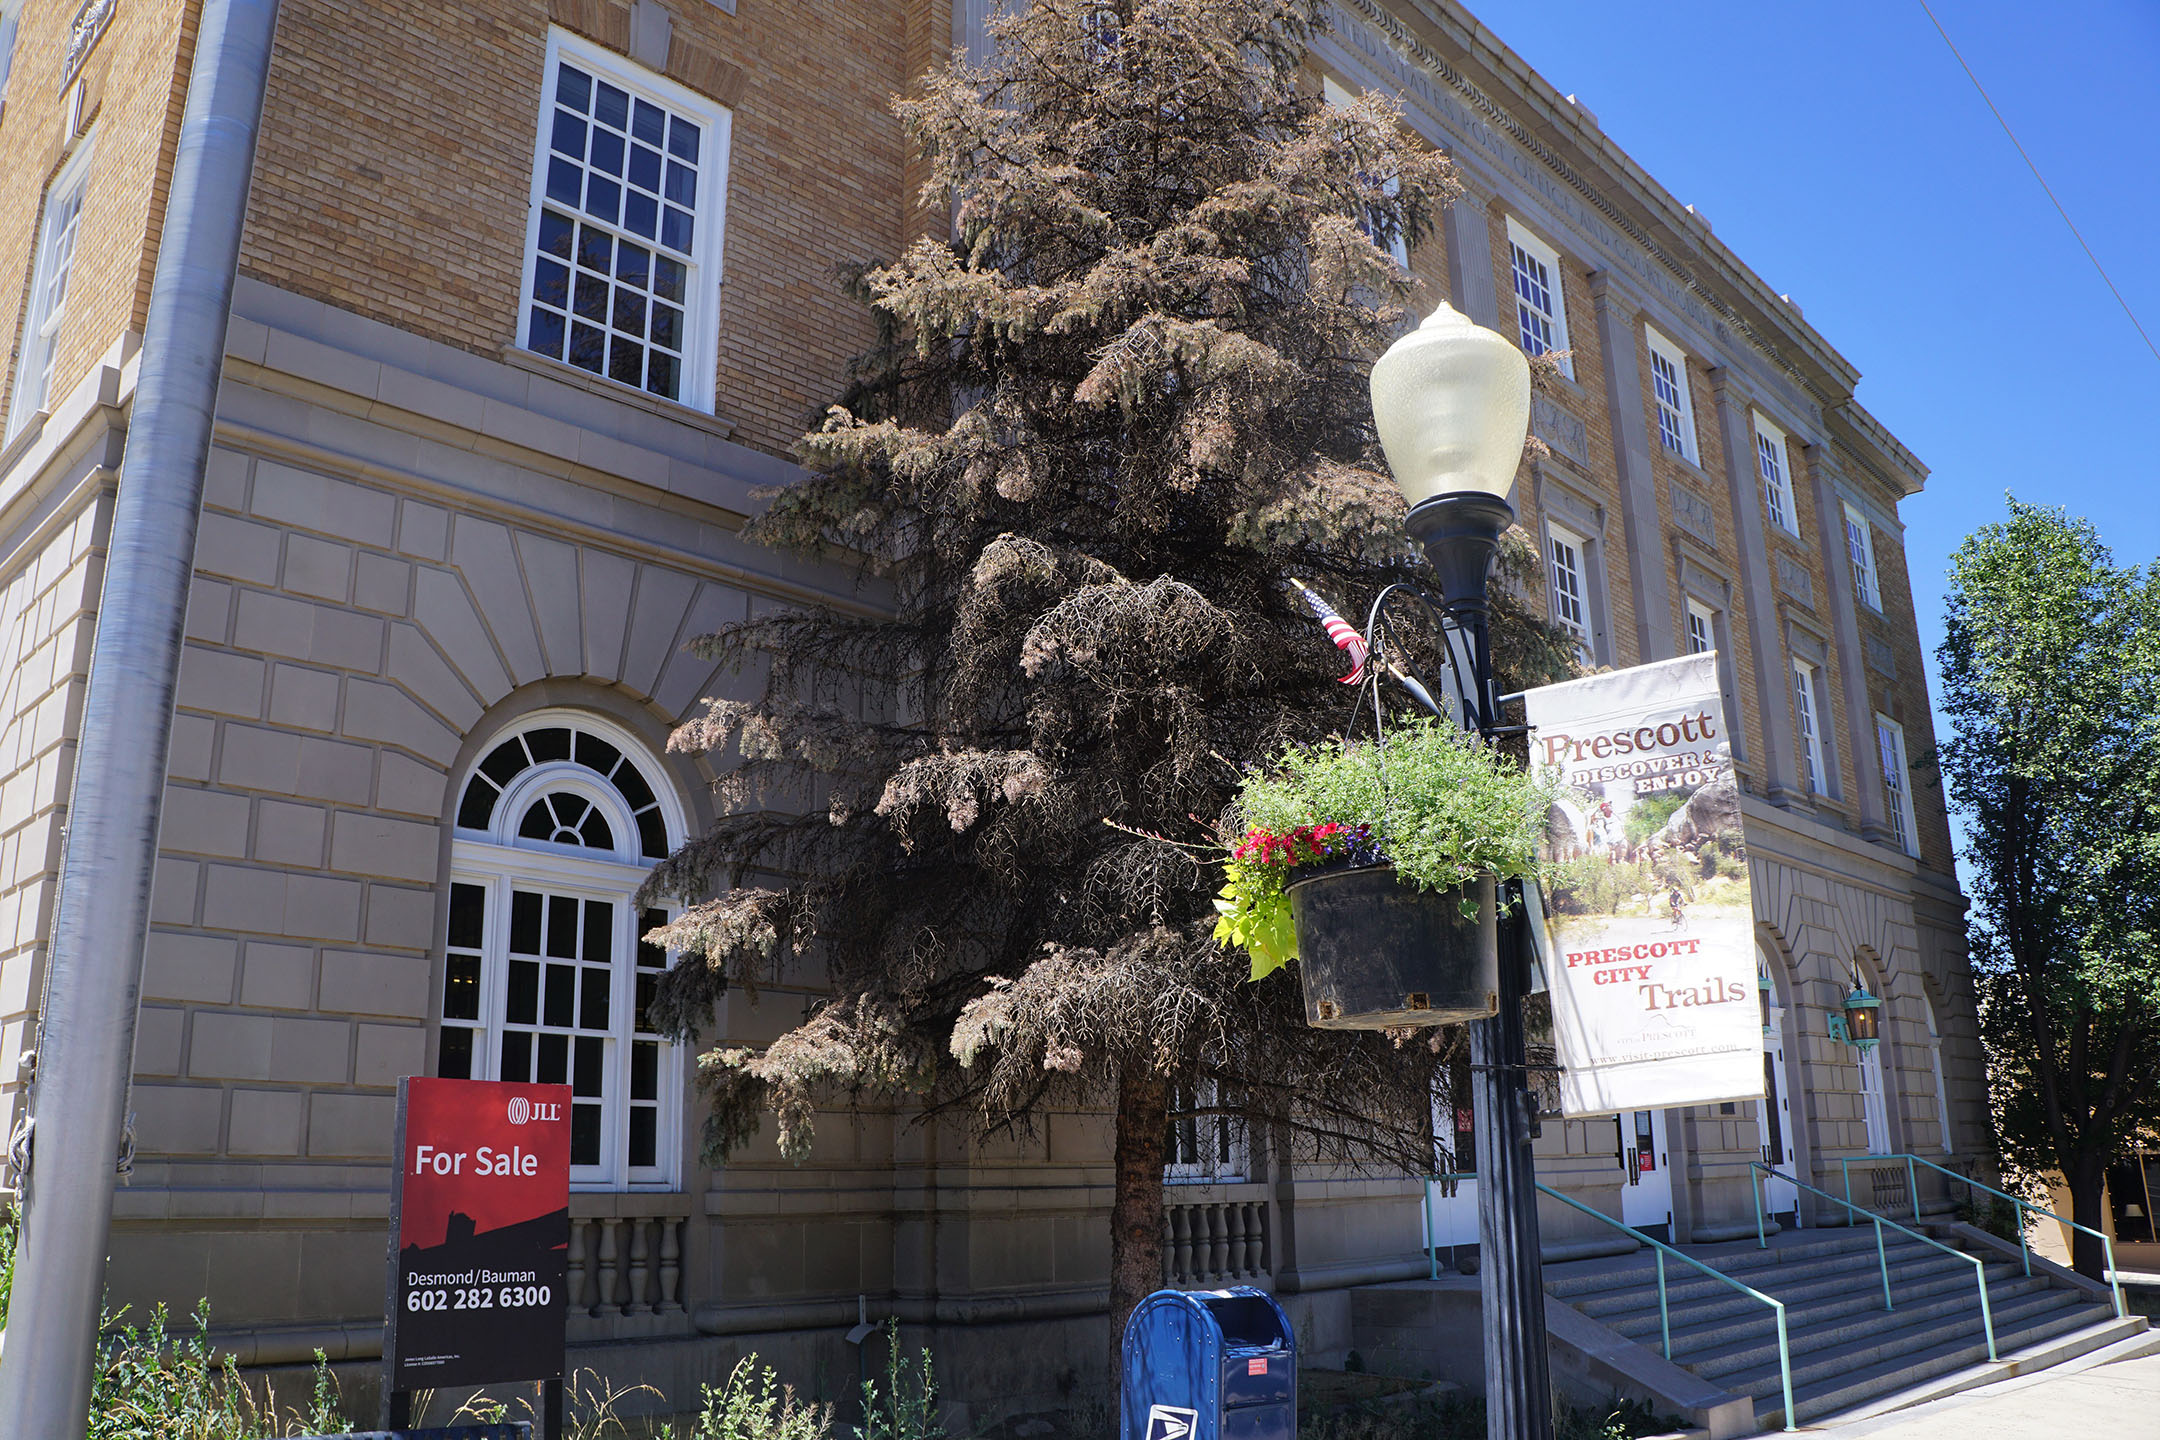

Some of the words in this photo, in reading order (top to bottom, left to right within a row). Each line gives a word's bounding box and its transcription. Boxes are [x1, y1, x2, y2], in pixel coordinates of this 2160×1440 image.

[1385, 49, 1456, 121] STATES
[1462, 110, 1504, 161] POST
[1513, 155, 1572, 218] OFFICE
[1580, 208, 1609, 246] AND
[1541, 709, 1716, 767] Prescott
[1571, 751, 1699, 787] DISCOVER
[1702, 750, 1718, 764] &
[1635, 766, 1720, 795] ENJOY
[1566, 938, 1701, 968] PRESCOTT
[1593, 964, 1653, 986] CITY
[1638, 976, 1746, 1012] Trails
[530, 1102, 561, 1121] JLL
[415, 1145, 467, 1175] For
[474, 1146, 538, 1177] Sale
[407, 1268, 536, 1287] Desmond/Bauman
[407, 1290, 448, 1313] 602
[453, 1287, 494, 1310] 282
[499, 1285, 551, 1308] 6300
